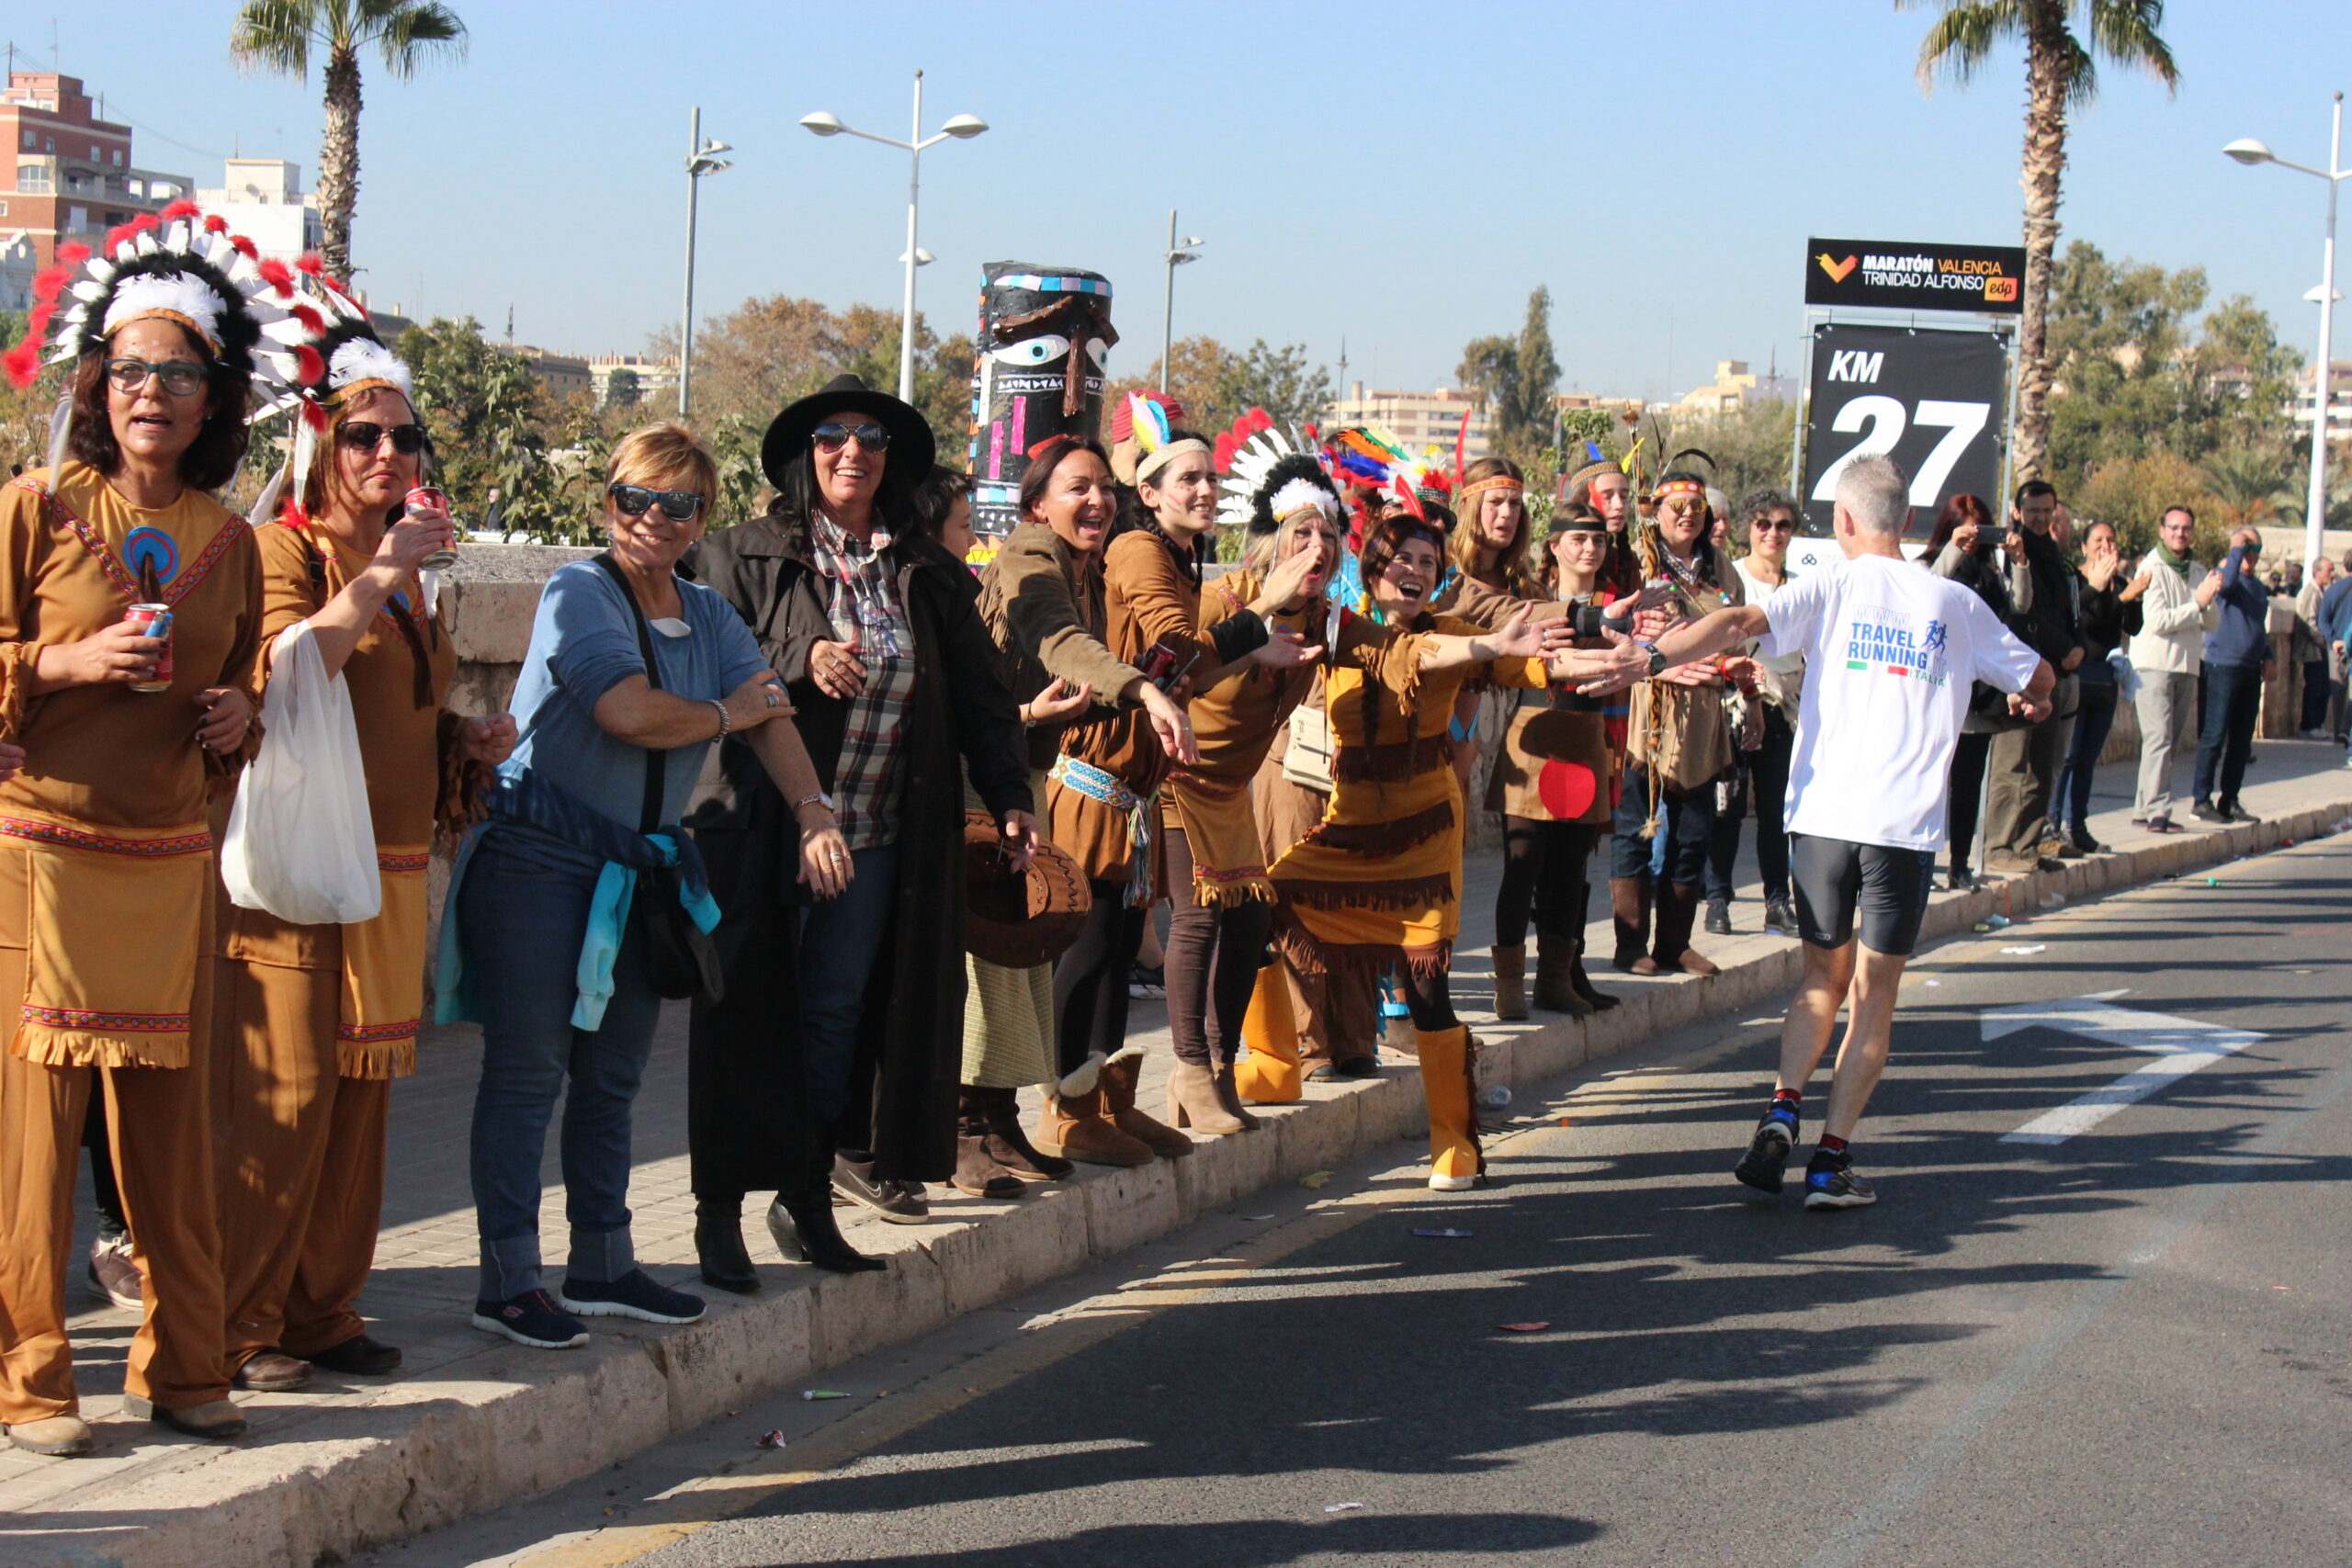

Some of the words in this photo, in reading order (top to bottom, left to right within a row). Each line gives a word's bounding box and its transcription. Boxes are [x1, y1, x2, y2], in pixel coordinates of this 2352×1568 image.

[1862, 254, 1934, 273] MARATÓN
[1938, 258, 2002, 276] VALENCIA
[1862, 271, 1920, 288] TRINIDAD
[1923, 275, 1984, 290] ALFONSO
[1989, 281, 2012, 299] edp
[1827, 350, 1884, 383] KM
[1811, 395, 1991, 507] 27
[1851, 623, 1917, 649] TRAVEL
[1909, 670, 1946, 687] ITALIA
